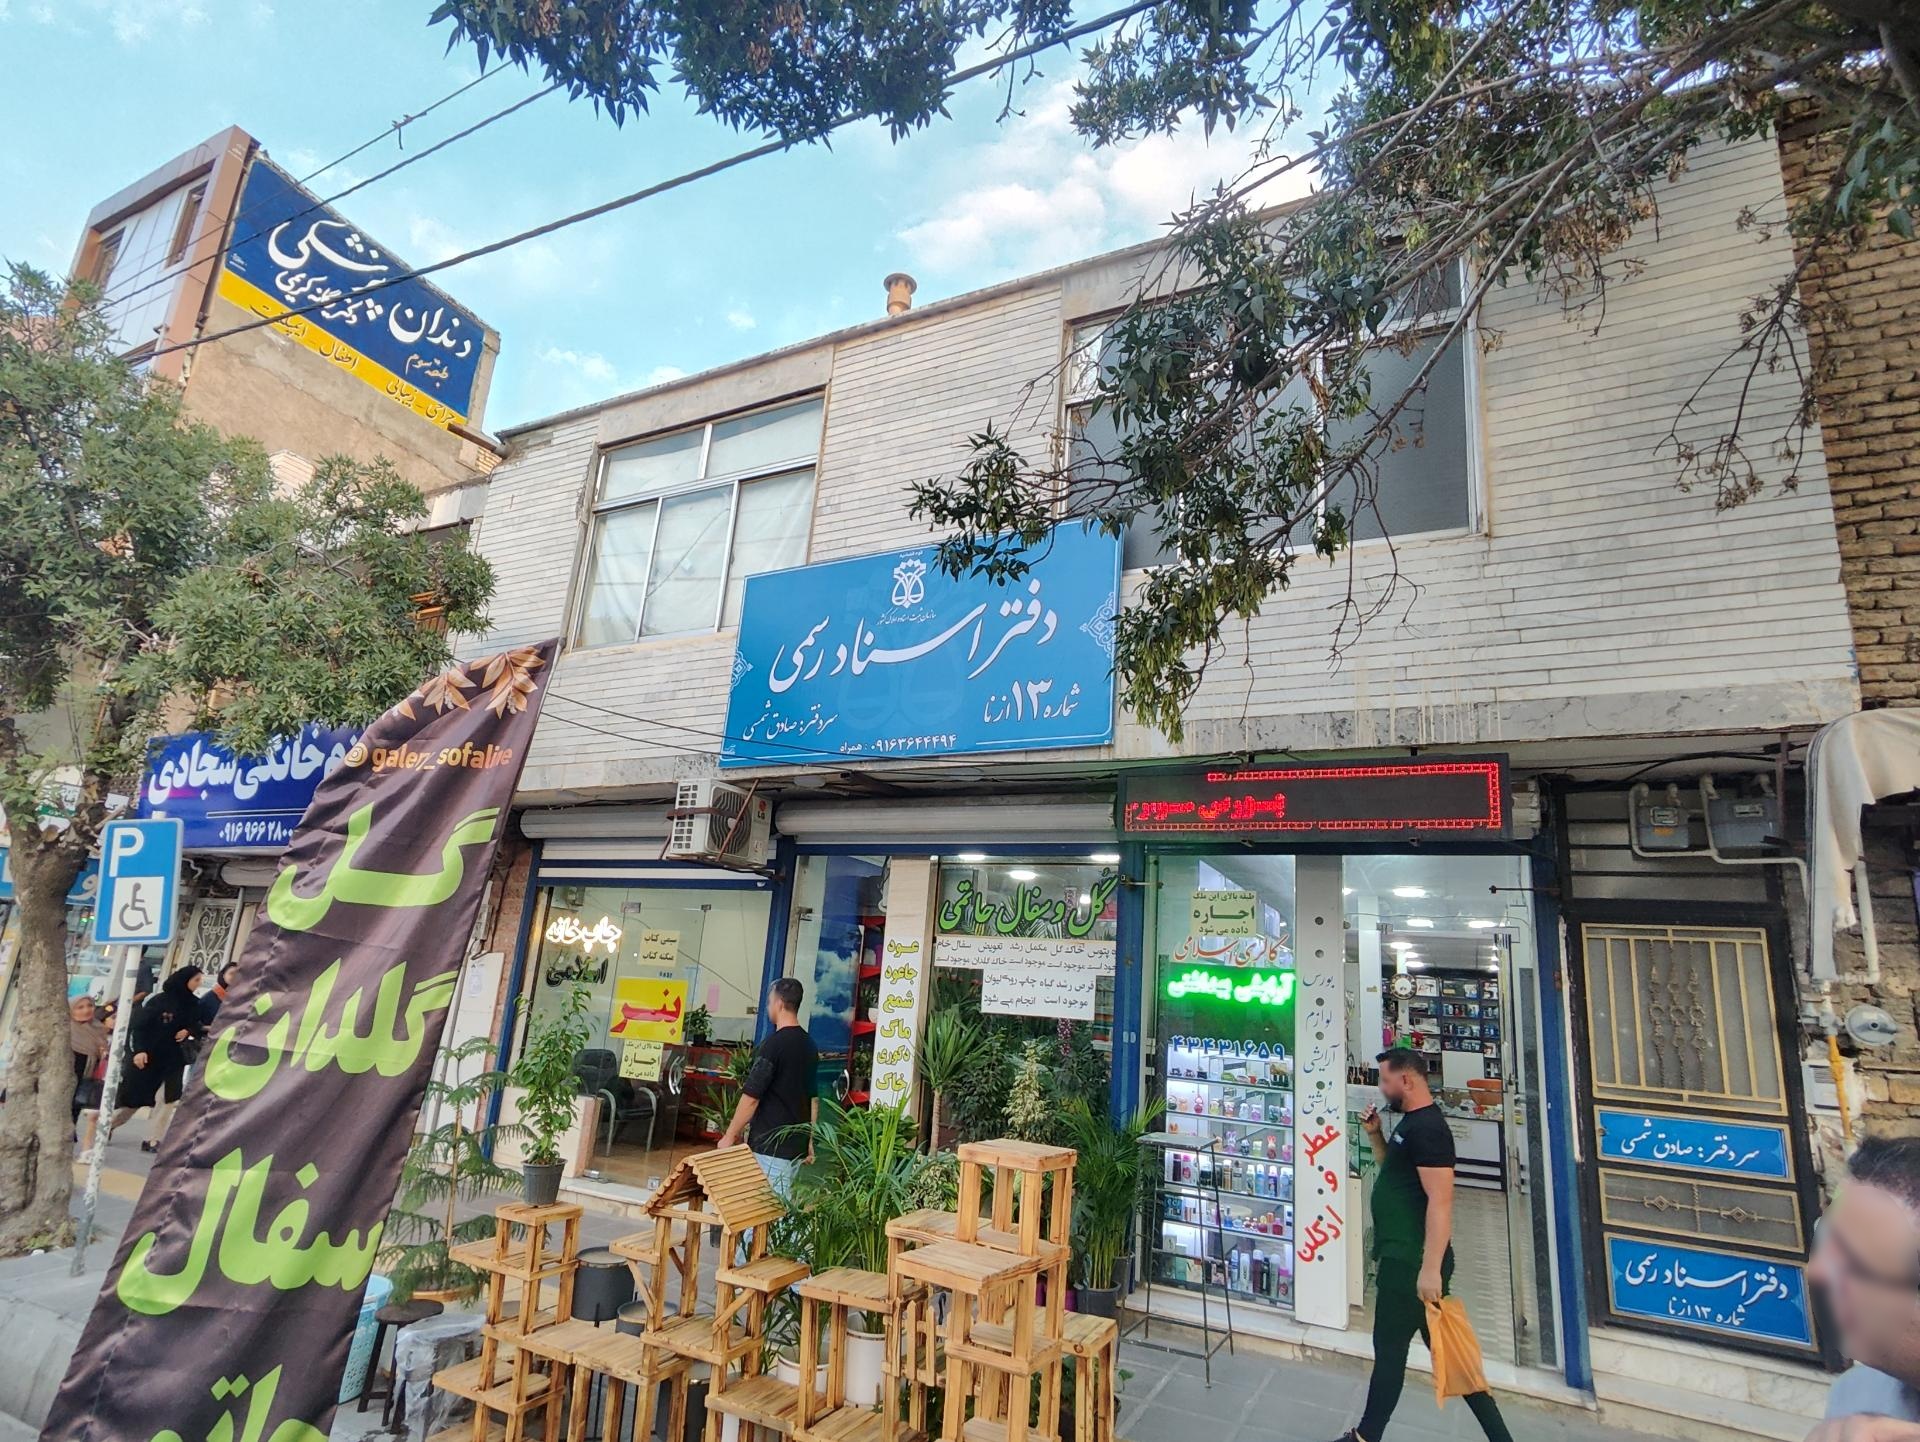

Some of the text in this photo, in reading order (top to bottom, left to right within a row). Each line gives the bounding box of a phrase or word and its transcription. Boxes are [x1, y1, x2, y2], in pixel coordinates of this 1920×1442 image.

[389, 302, 472, 357] دندان
[769, 577, 1058, 693] دفتر اسناد رسمی
[1012, 679, 1053, 721] ۱۳
[1043, 683, 1081, 718] شماره
[742, 700, 772, 740] شمسی
[766, 712, 797, 740] صادق
[148, 740, 237, 804] سجادی
[109, 827, 144, 877] P
[267, 801, 501, 931] گل
[939, 880, 996, 930] حاتمی
[996, 882, 1052, 934] سفال
[1051, 900, 1066, 924] و
[1193, 905, 1255, 924] اجاره
[1231, 926, 1249, 934] داده
[886, 939, 920, 958] عود
[1056, 980, 1072, 991] رشد
[1302, 973, 1335, 988] بورس
[610, 988, 682, 1036] بنر
[882, 990, 915, 1013] شمع
[1063, 997, 1089, 1008] موجود
[204, 956, 458, 1101] گلدان
[880, 1018, 912, 1040] ماگ
[1305, 1009, 1333, 1032] لوازم
[624, 1052, 660, 1069] اجاره
[876, 1045, 911, 1066] دکوری
[1171, 1035, 1286, 1061] ۴۳۴۳۱۶۵۹
[1303, 1043, 1340, 1073] آرایشی
[875, 1072, 907, 1092] خاک
[1302, 1091, 1340, 1120] بهداشتی
[1302, 1125, 1342, 1166] عطر
[1621, 1118, 1653, 1154] شمسی
[1653, 1133, 1693, 1159] صادق
[1324, 1170, 1338, 1193] و
[116, 1146, 384, 1317] سفال
[1625, 1252, 1789, 1306] دفتر اسناد رسمی
[1693, 1304, 1712, 1319] ۱۳
[1715, 1304, 1746, 1326] شماره
